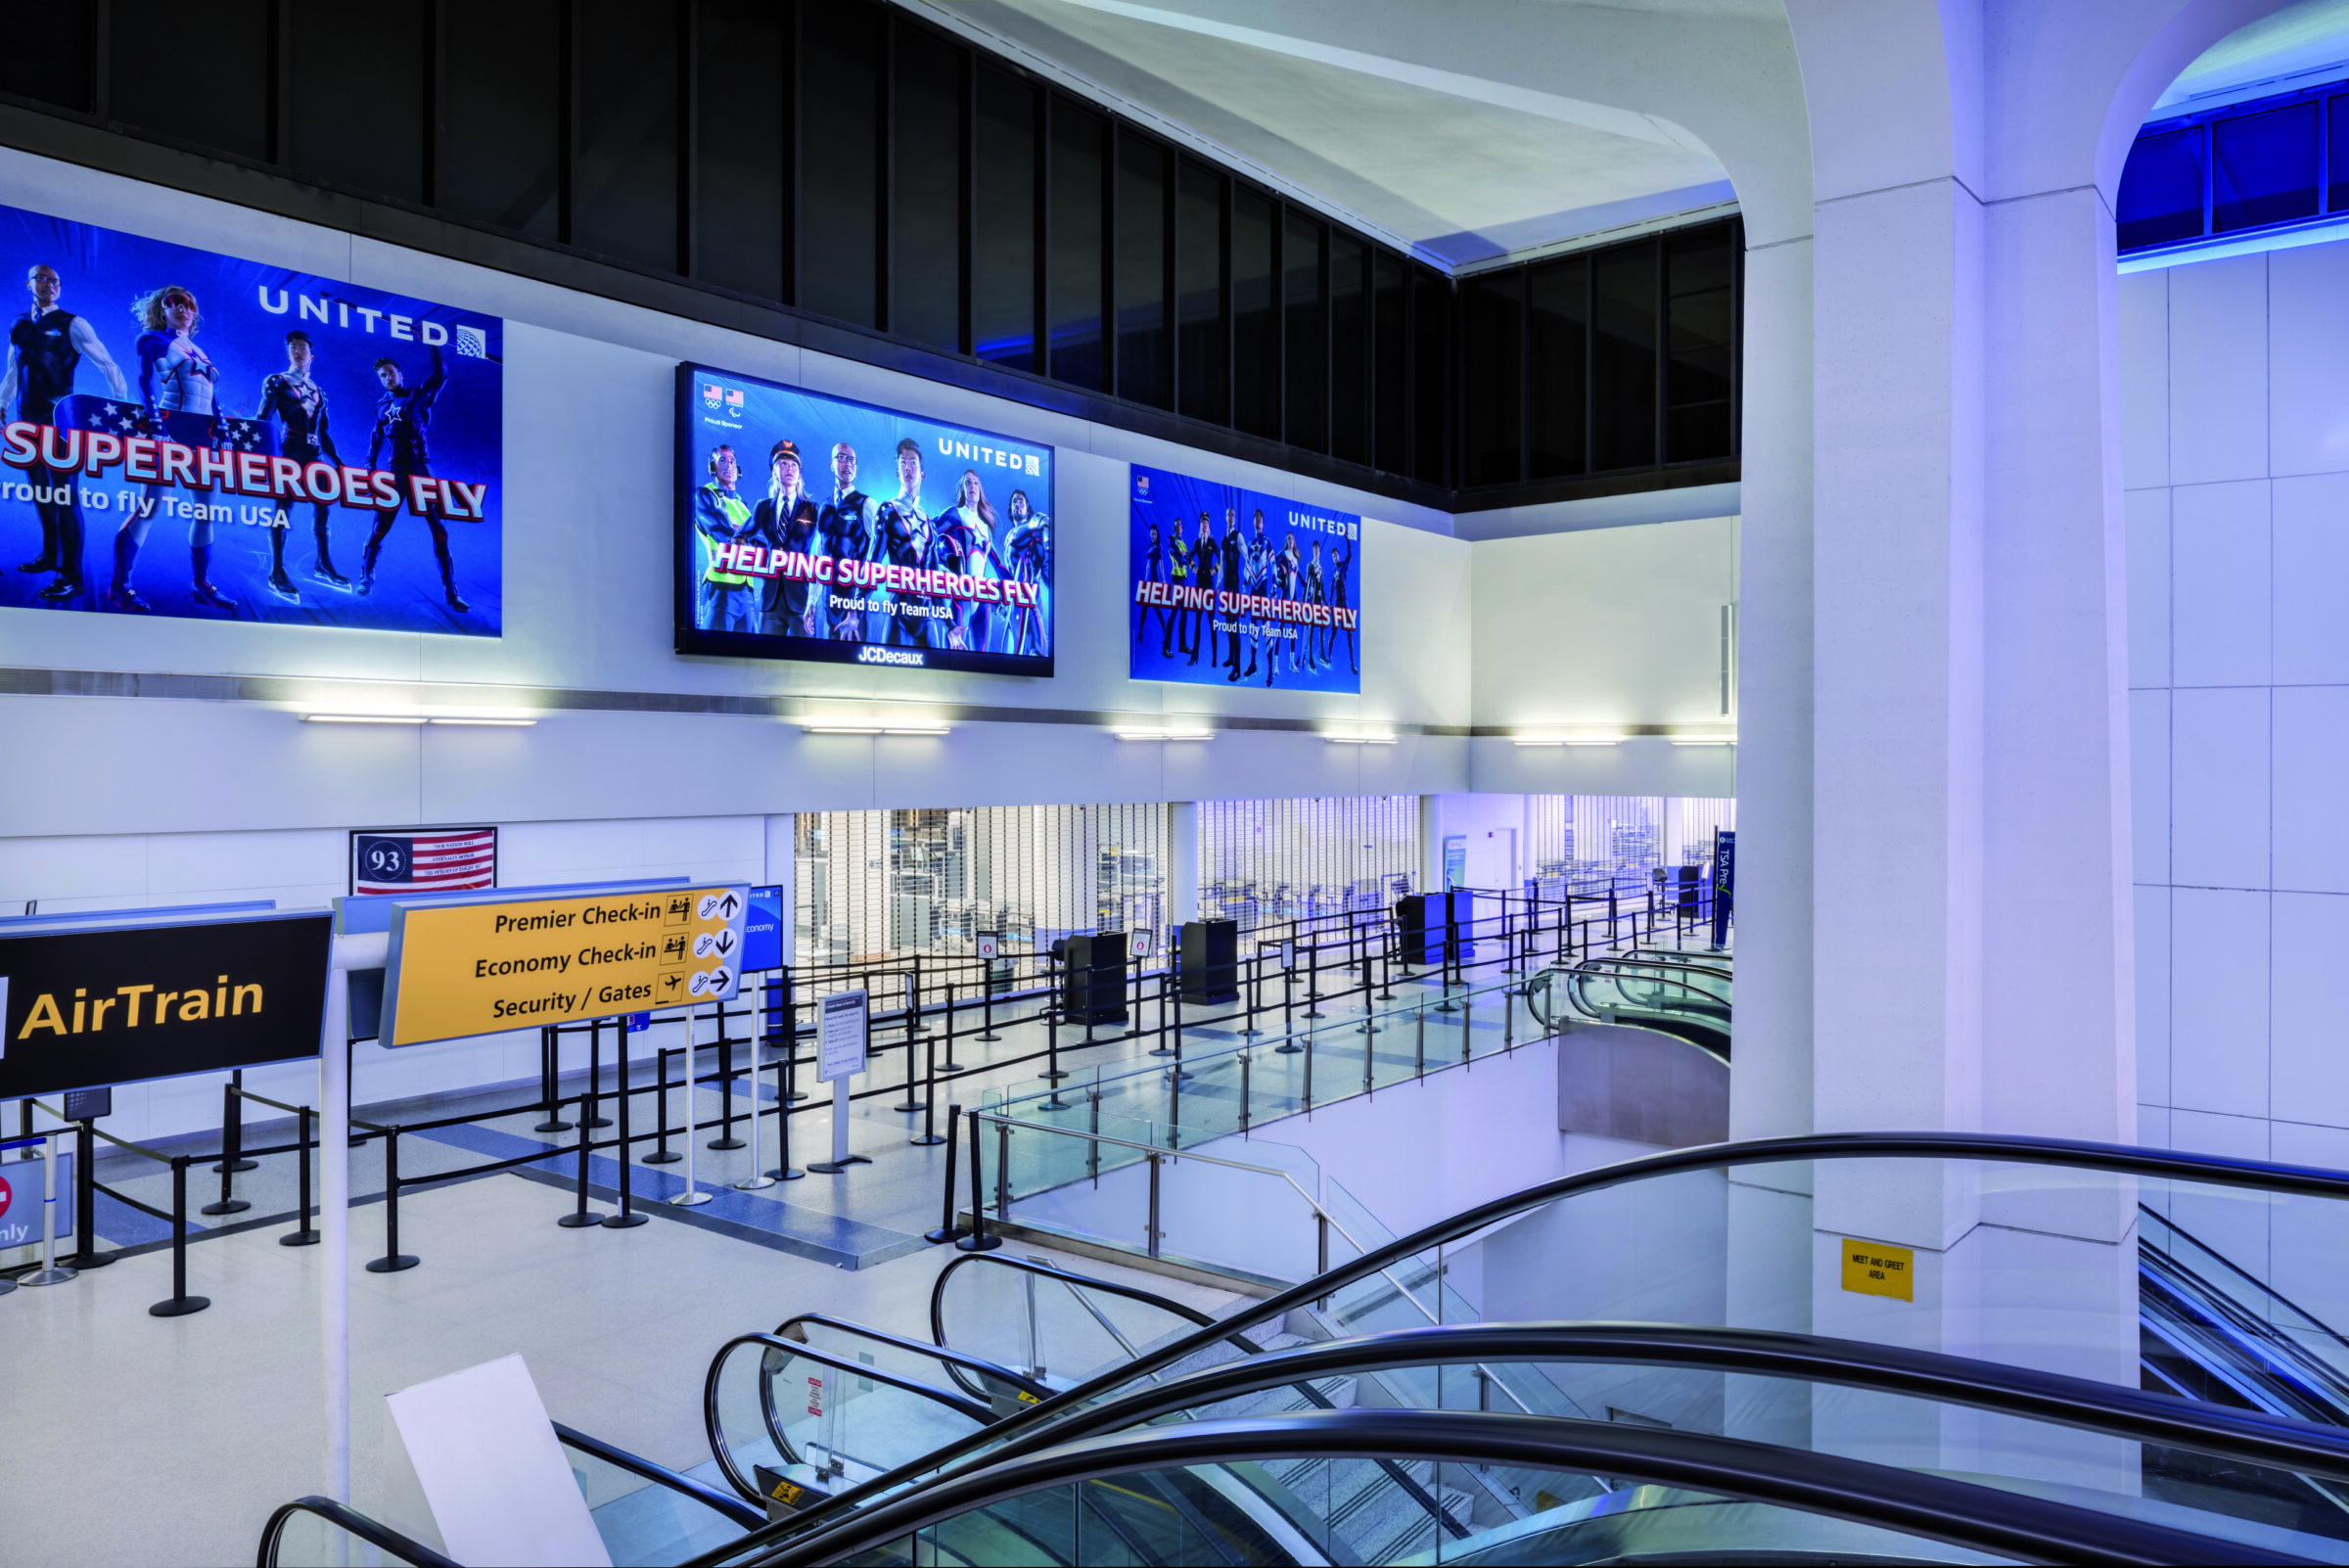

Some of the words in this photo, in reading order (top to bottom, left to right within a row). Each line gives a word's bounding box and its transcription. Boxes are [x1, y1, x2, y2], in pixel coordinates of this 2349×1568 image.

[258, 286, 449, 346] UNITED
[939, 438, 1023, 470] UNITED
[2, 420, 400, 511] SUPERHEROES
[409, 473, 488, 522] FLY
[0, 481, 71, 506] roud
[80, 486, 109, 510] to
[117, 490, 156, 518] fly
[162, 495, 233, 523] Team
[241, 505, 291, 530] USA
[1289, 511, 1346, 535] UNITED
[714, 542, 832, 584] HELPING
[838, 559, 999, 602] SUPERHEROES
[1003, 579, 1038, 607] FLY
[830, 595, 864, 611] Proud
[868, 600, 879, 612] to
[883, 601, 898, 616] fly
[900, 603, 929, 618] Team
[932, 607, 953, 620] USA
[1135, 580, 1215, 613] HELPING
[1218, 591, 1331, 627] SUPERHEROES
[1332, 606, 1358, 631] FLY
[1213, 620, 1237, 633] Proud
[1239, 623, 1247, 634] to
[1249, 623, 1260, 637] fly
[1262, 624, 1281, 638] Team
[1283, 626, 1298, 639] USA
[859, 647, 923, 665] JCDecaux
[371, 851, 399, 871] 93
[1720, 849, 1729, 867] TSA
[1720, 868, 1729, 884] Pre
[495, 910, 576, 933] Premier
[582, 902, 661, 925] Check-in
[746, 923, 774, 933] conomy
[475, 954, 571, 978] Economy
[577, 942, 656, 966] Check-in
[18, 975, 264, 1039] AirTrain
[493, 992, 576, 1018] Security
[580, 987, 592, 1010] /
[598, 984, 652, 1003] Gates
[0, 1223, 28, 1242] nly
[1852, 1254, 1868, 1265] MEET
[1870, 1256, 1883, 1268] AND
[1884, 1260, 1905, 1270] GREET
[1868, 1269, 1884, 1280] AREA
